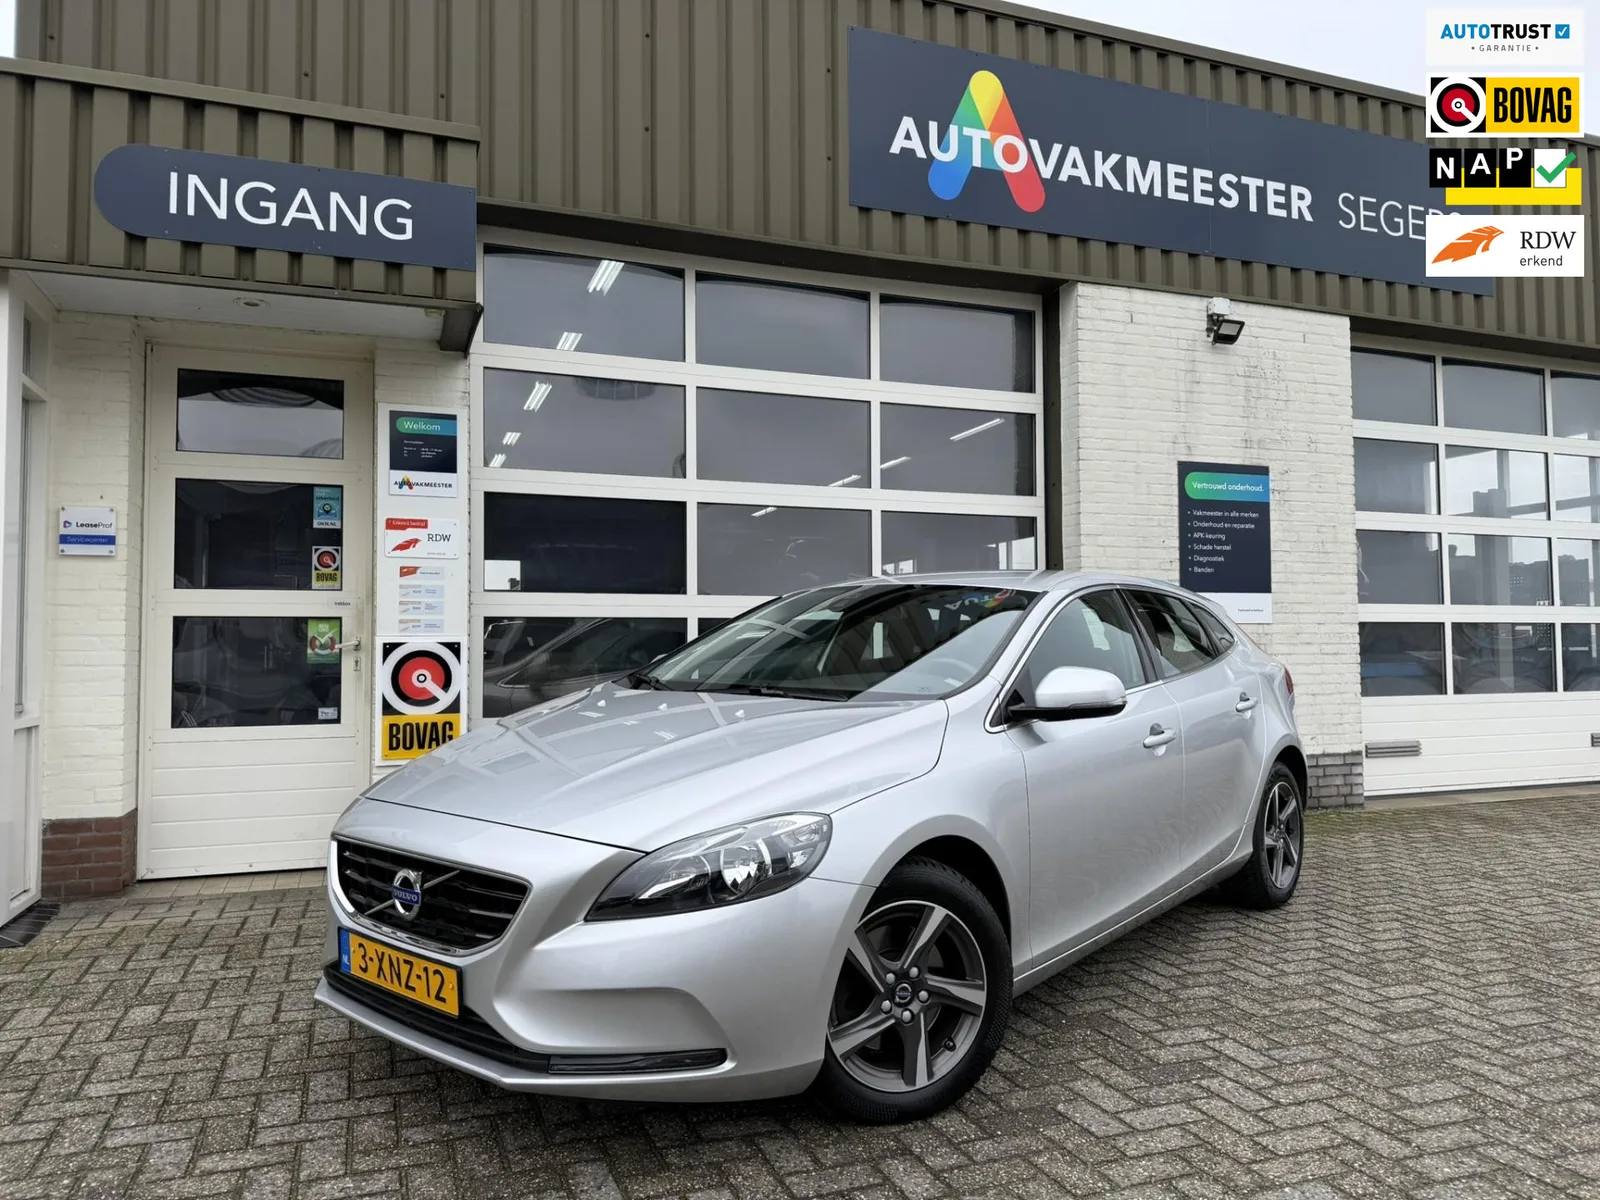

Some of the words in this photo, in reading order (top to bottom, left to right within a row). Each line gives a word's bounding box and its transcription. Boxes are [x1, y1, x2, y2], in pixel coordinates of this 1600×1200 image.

[889, 115, 1313, 222] AUTOVAKMEESTER
[1338, 192, 1462, 241] SEGE
[168, 171, 413, 241] INGANG
[403, 420, 441, 431] Welkom
[394, 480, 453, 489] AUTOVAKMEESTER
[1192, 481, 1227, 490] Vertrouwd
[1193, 509, 1223, 517] Vakmeester
[76, 521, 113, 529] LeaseProf
[1193, 520, 1224, 528] Onderhoud
[1232, 522, 1255, 530] reparatie
[427, 533, 451, 542] RDW
[1205, 533, 1226, 541] keuring
[1193, 554, 1225, 563] Diagnostiek
[316, 572, 338, 582] BOVAG
[388, 720, 454, 752] BOVAG
[393, 888, 418, 902] VOLVO
[357, 942, 447, 1004] 3-XNZ-12
